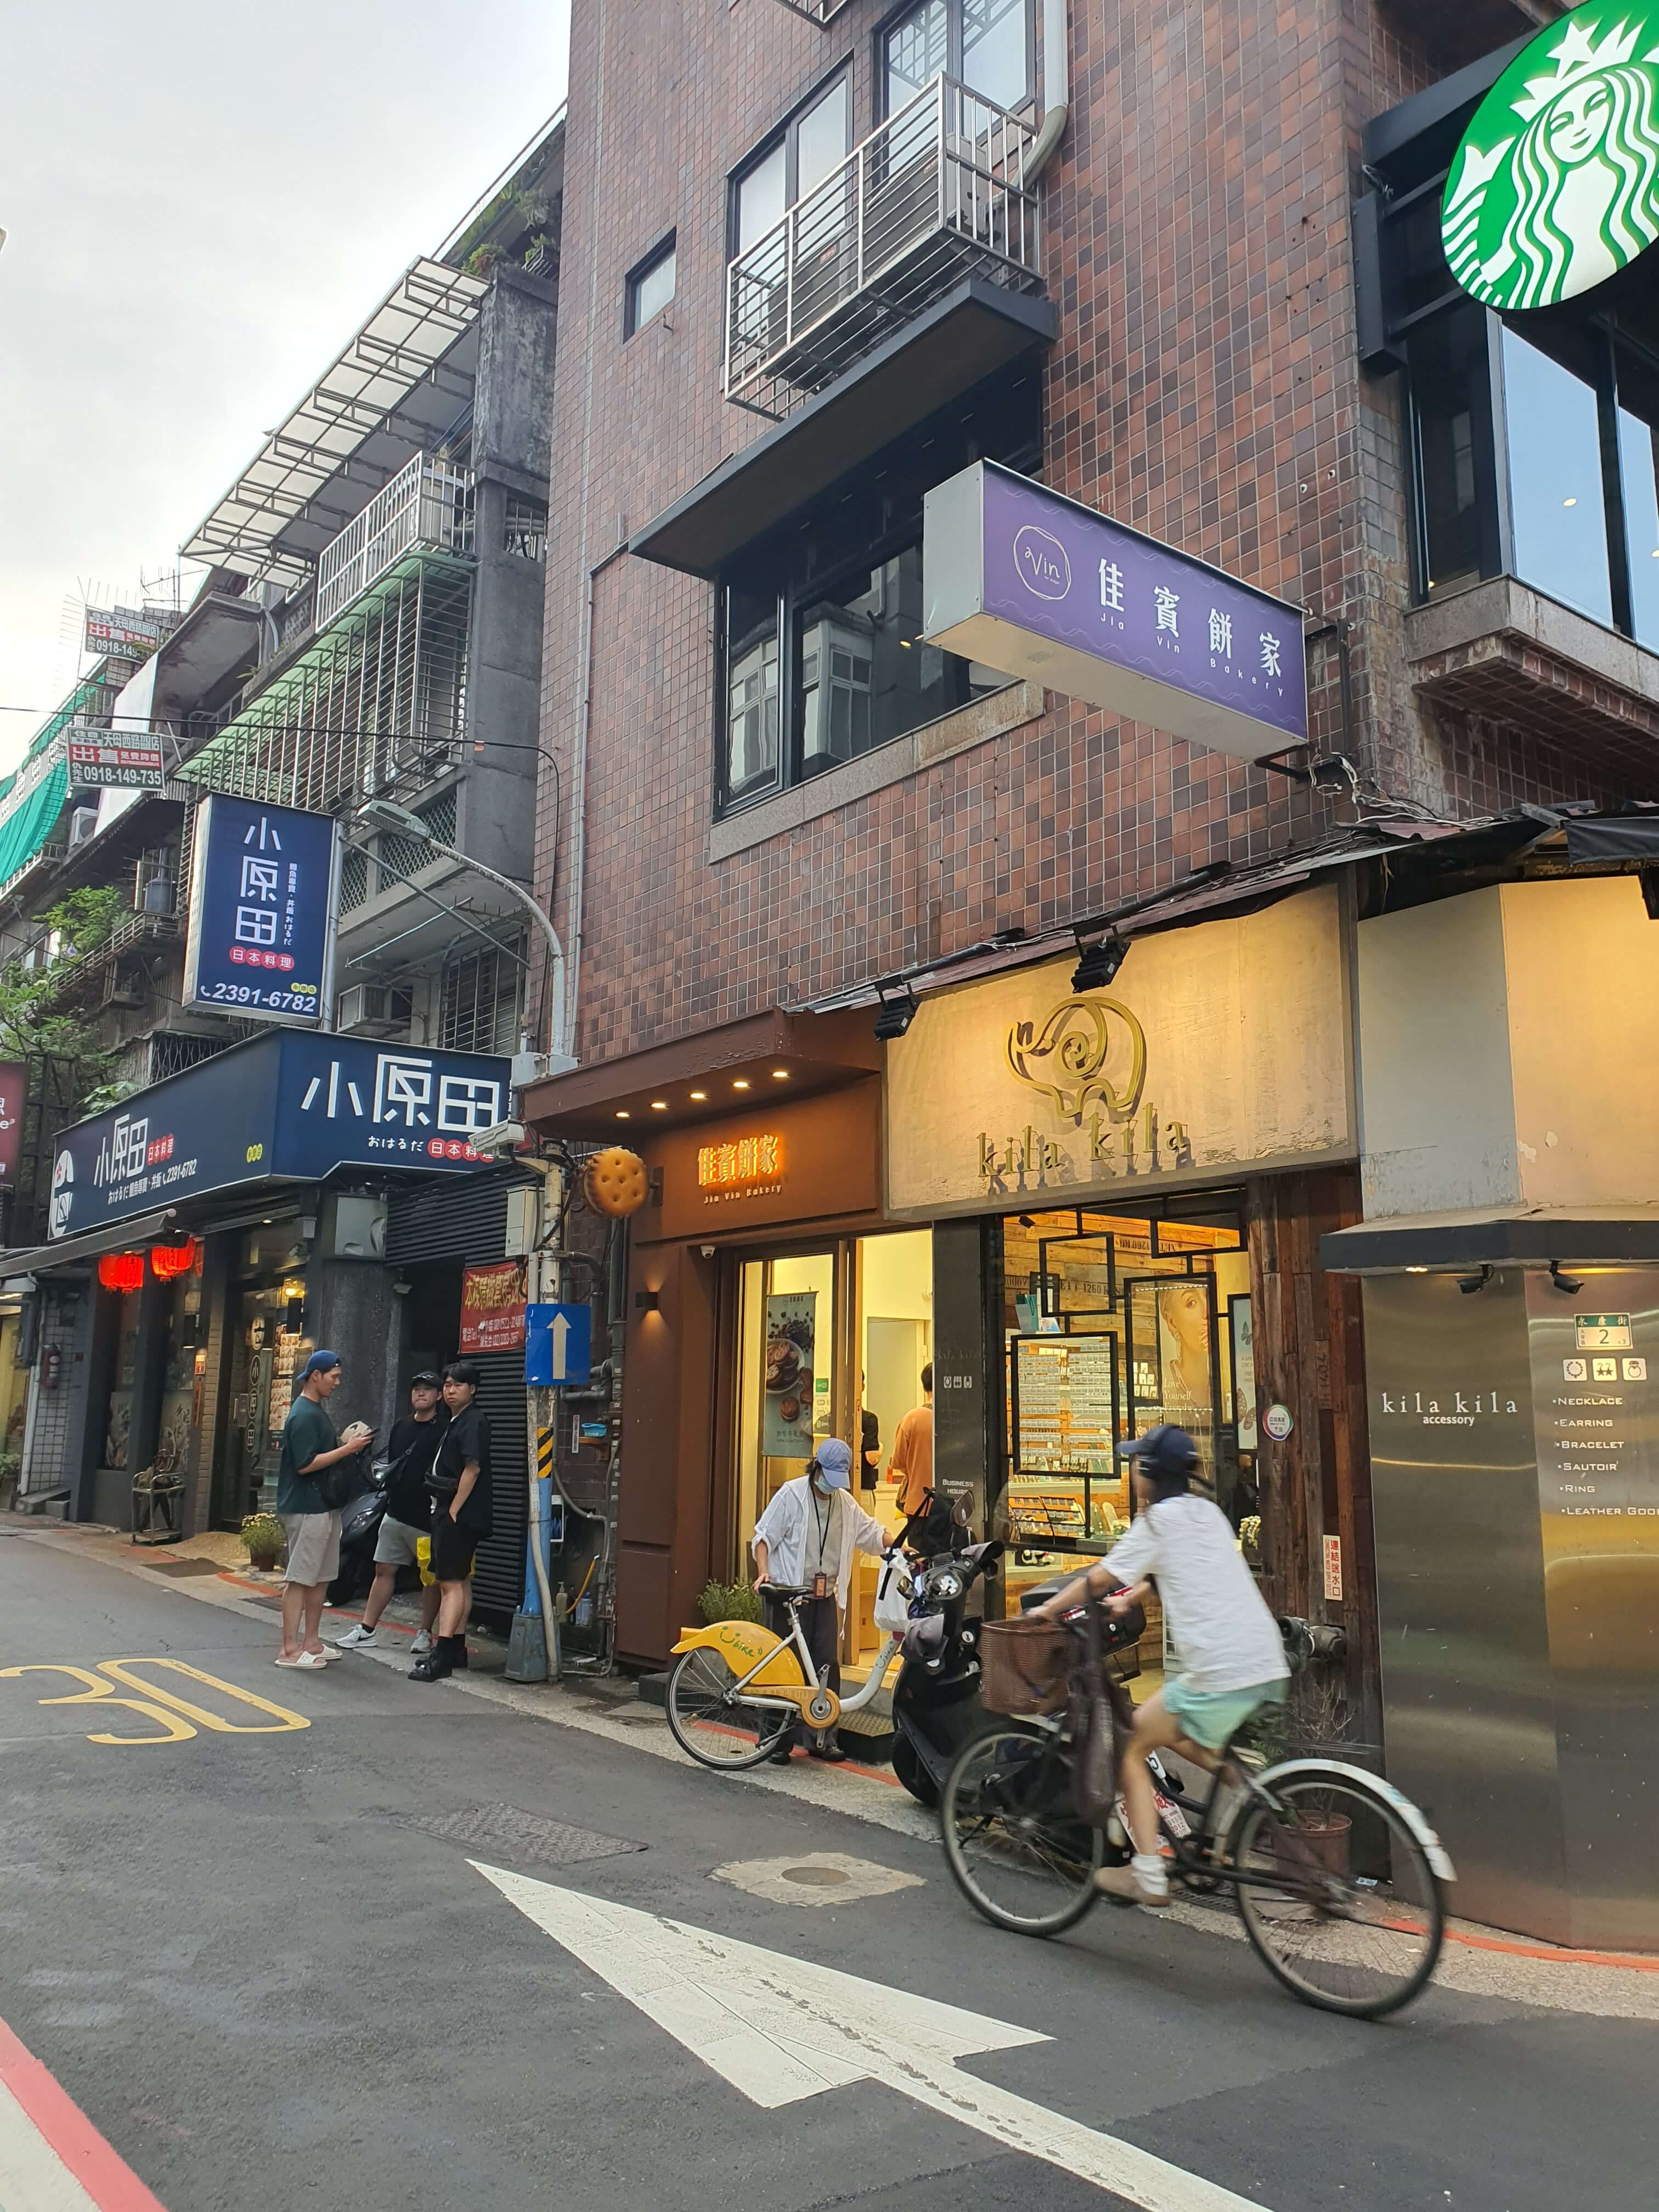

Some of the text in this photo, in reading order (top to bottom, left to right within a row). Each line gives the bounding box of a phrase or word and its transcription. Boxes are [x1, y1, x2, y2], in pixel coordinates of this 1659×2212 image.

[1024, 546, 1060, 578] Vin
[1098, 558, 1282, 678] 佳賓餅家
[96, 639, 141, 657] 0918-149-
[1101, 613, 1283, 697] Jia Vin Bakery
[72, 747, 119, 764] 出售
[84, 766, 161, 785] 0918-149-735
[235, 816, 281, 945] 小原田
[233, 949, 292, 969] 日本料理
[212, 983, 317, 1012] 2391-6782
[301, 1054, 500, 1133] 小原田
[368, 1135, 424, 1152] おはるだ
[977, 1102, 1190, 1177] kila kila
[93, 1113, 149, 1188] 小原田
[698, 1134, 778, 1186] 佳賓餅家
[167, 1159, 198, 1184] 2391-6782
[704, 1185, 782, 1204] Jia Vin Bakery
[1577, 1316, 1628, 1327] 永康街
[1599, 1329, 1610, 1344] 2
[1381, 1391, 1518, 1413] kila kila
[1423, 1416, 1475, 1426] accessory
[1560, 1419, 1613, 1427] EARRING
[1561, 1441, 1624, 1449] BRACELET
[1563, 1463, 1617, 1471] SAUTOIR
[943, 1479, 974, 1487] BUSINESS
[1565, 1485, 1596, 1493] RING
[1566, 1507, 1659, 1516] LEATHER GOO
[1330, 1540, 1340, 1596] 連結送水口
[0, 1658, 312, 1745] 30
